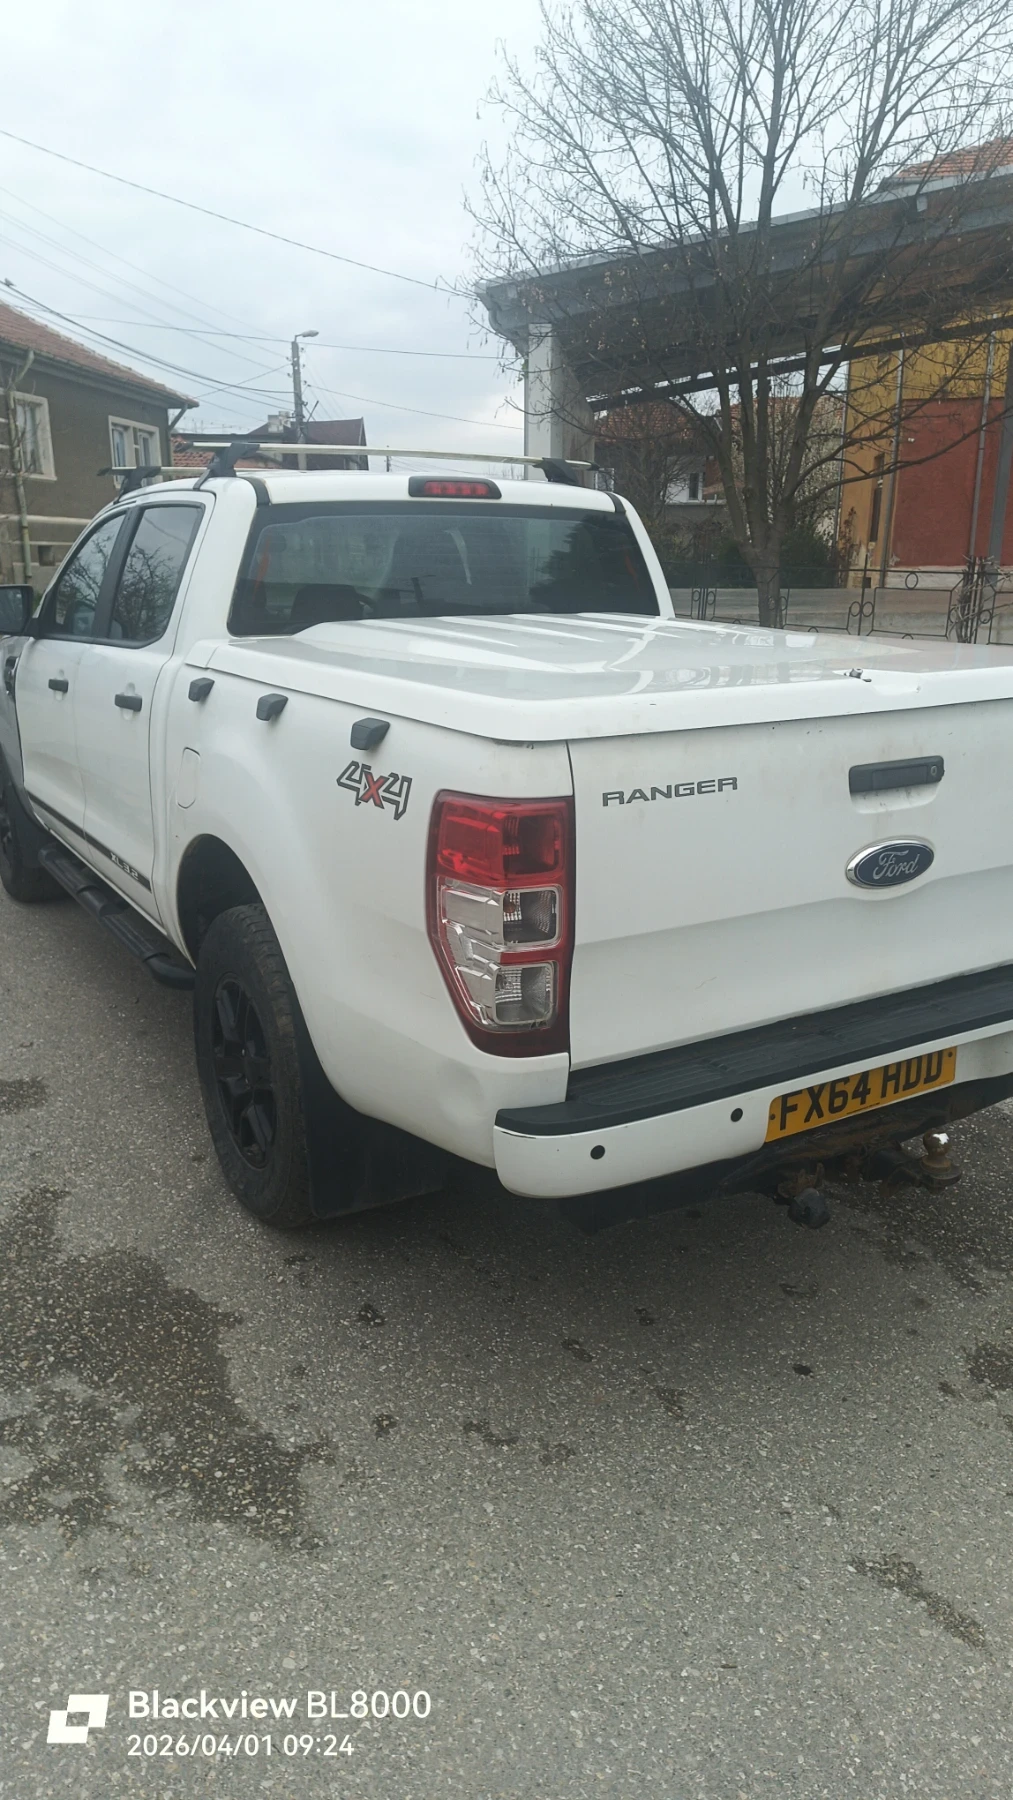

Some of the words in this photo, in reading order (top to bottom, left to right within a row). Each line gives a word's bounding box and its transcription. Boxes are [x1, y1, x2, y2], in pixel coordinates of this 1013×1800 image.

[602, 777, 738, 807] RANGER
[872, 849, 921, 880] Ford
[779, 1070, 872, 1131] FX64
[880, 1050, 944, 1099] HDD
